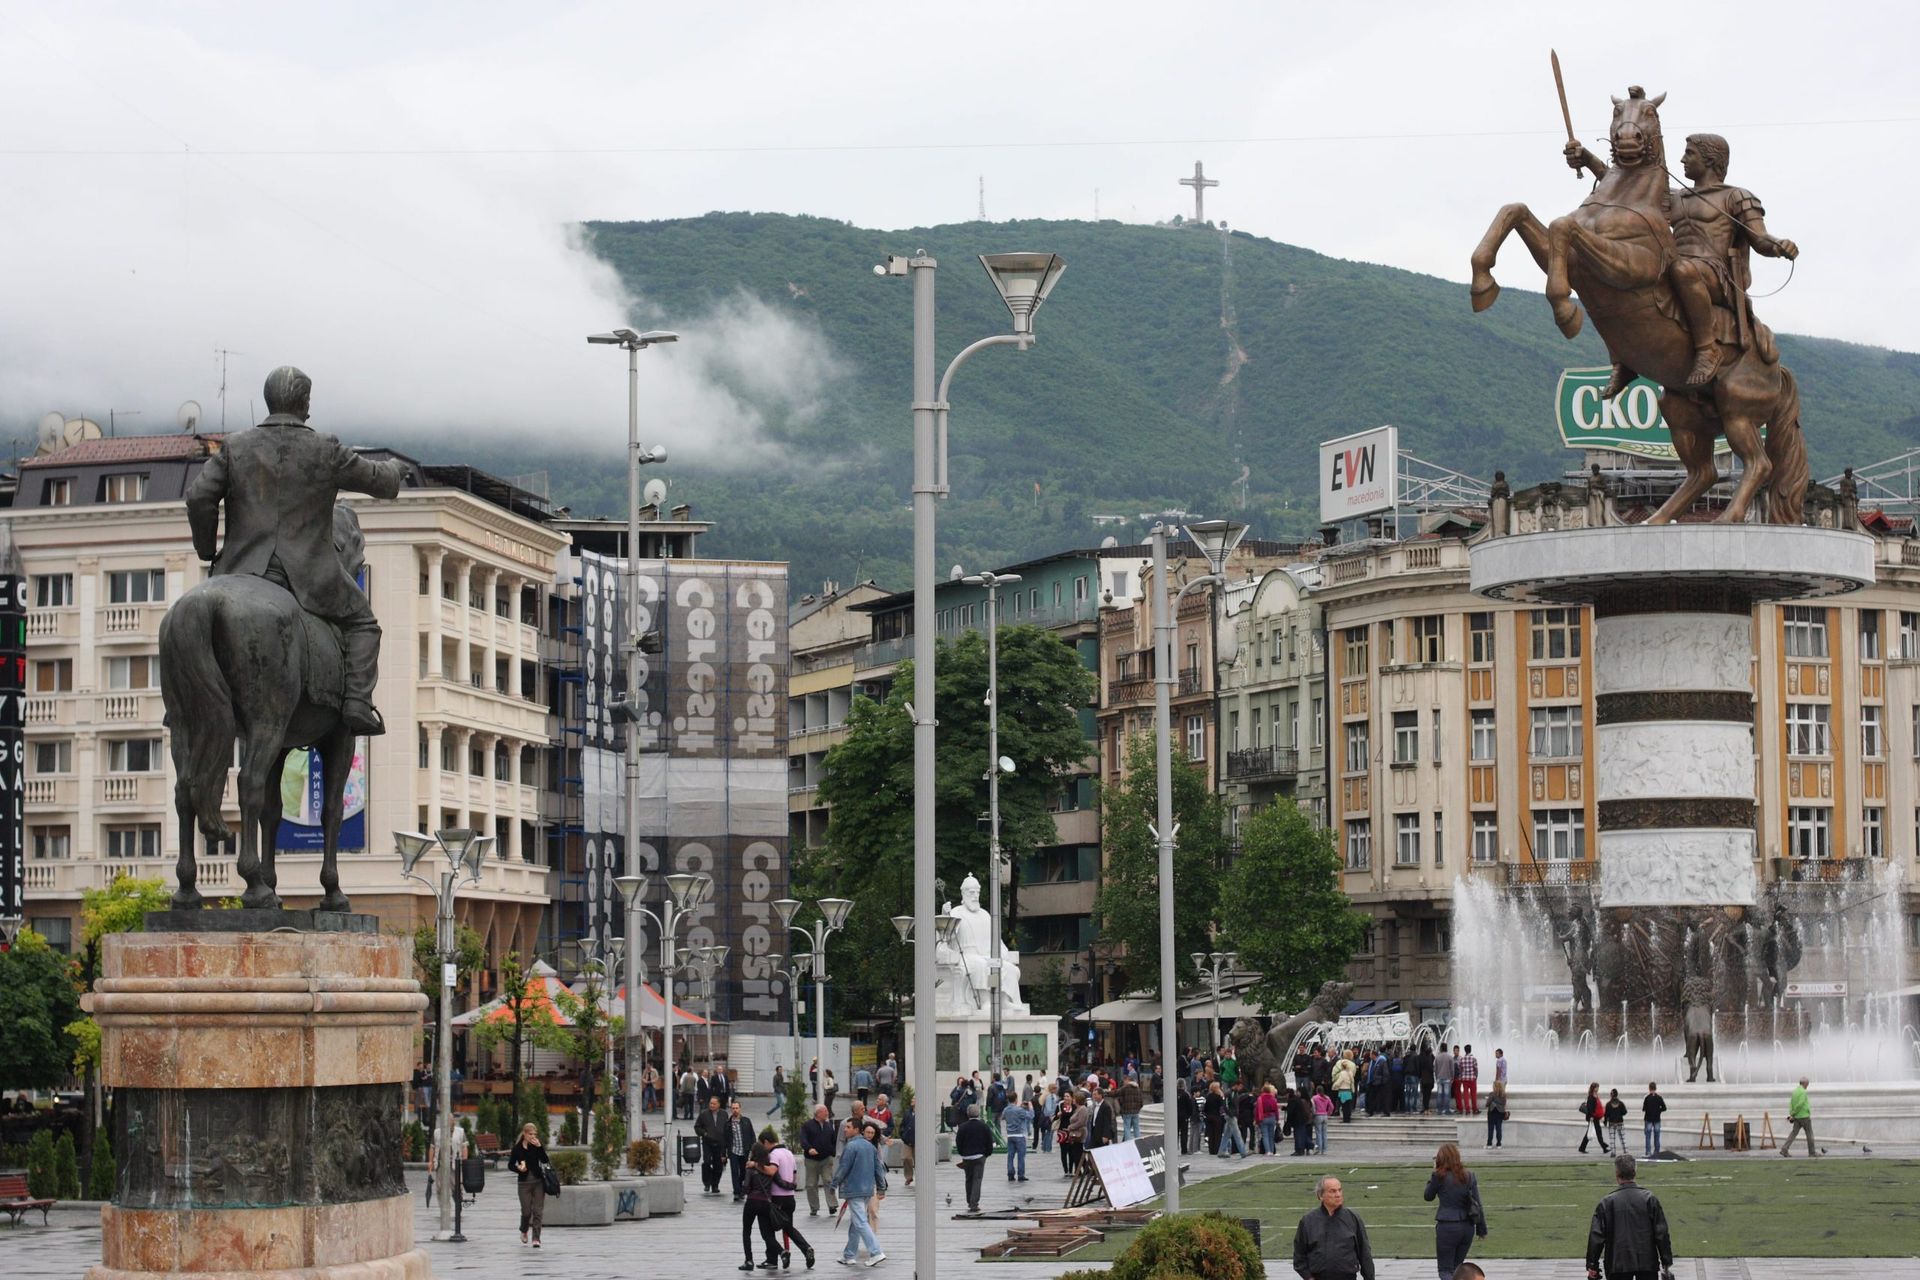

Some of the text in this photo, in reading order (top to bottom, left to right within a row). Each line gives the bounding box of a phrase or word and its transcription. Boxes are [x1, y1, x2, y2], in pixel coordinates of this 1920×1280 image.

[1331, 444, 1376, 491] EVN
[1347, 488, 1385, 505] macedonia
[313, 771, 321, 819] ЖИВОТ
[742, 841, 784, 1016] Ceresit
